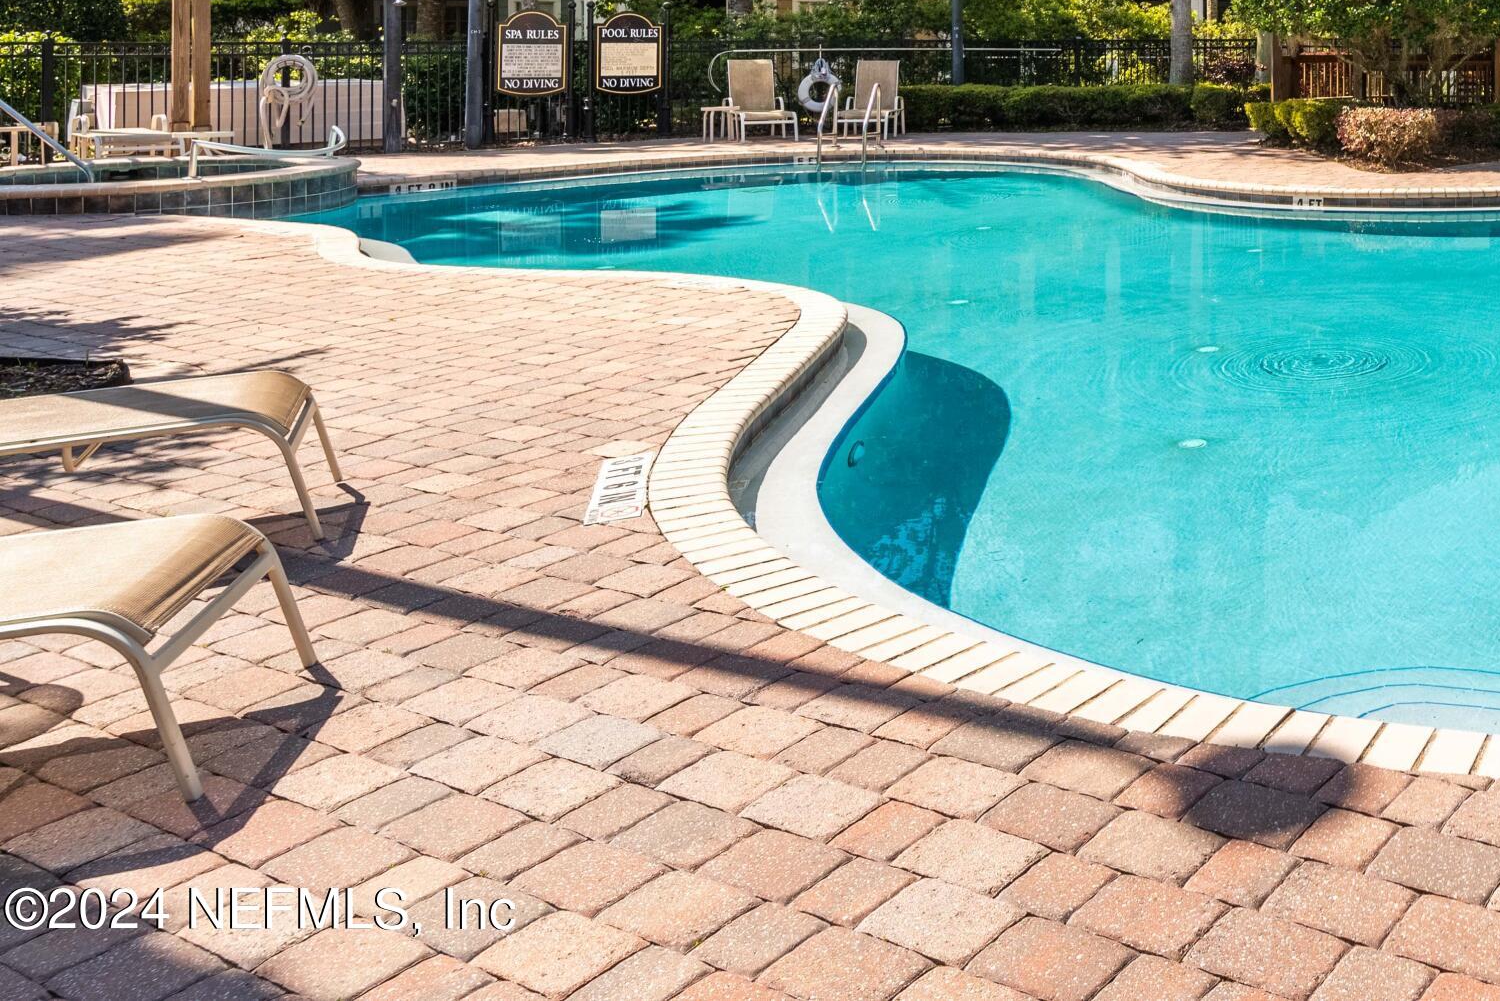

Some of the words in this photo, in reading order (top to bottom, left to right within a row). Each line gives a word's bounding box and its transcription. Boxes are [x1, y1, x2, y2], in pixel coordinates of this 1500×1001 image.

[505, 29, 522, 40] SPA
[526, 29, 559, 40] RULES
[601, 28, 627, 38] POOL
[630, 28, 658, 38] RULES
[504, 79, 520, 89] NO
[523, 79, 559, 89] DIVING
[602, 78, 618, 88] NO
[620, 78, 654, 88] DIVING
[610, 456, 644, 466] 3
[605, 465, 643, 479] FT
[603, 480, 639, 490] 6
[597, 490, 637, 506] IN
